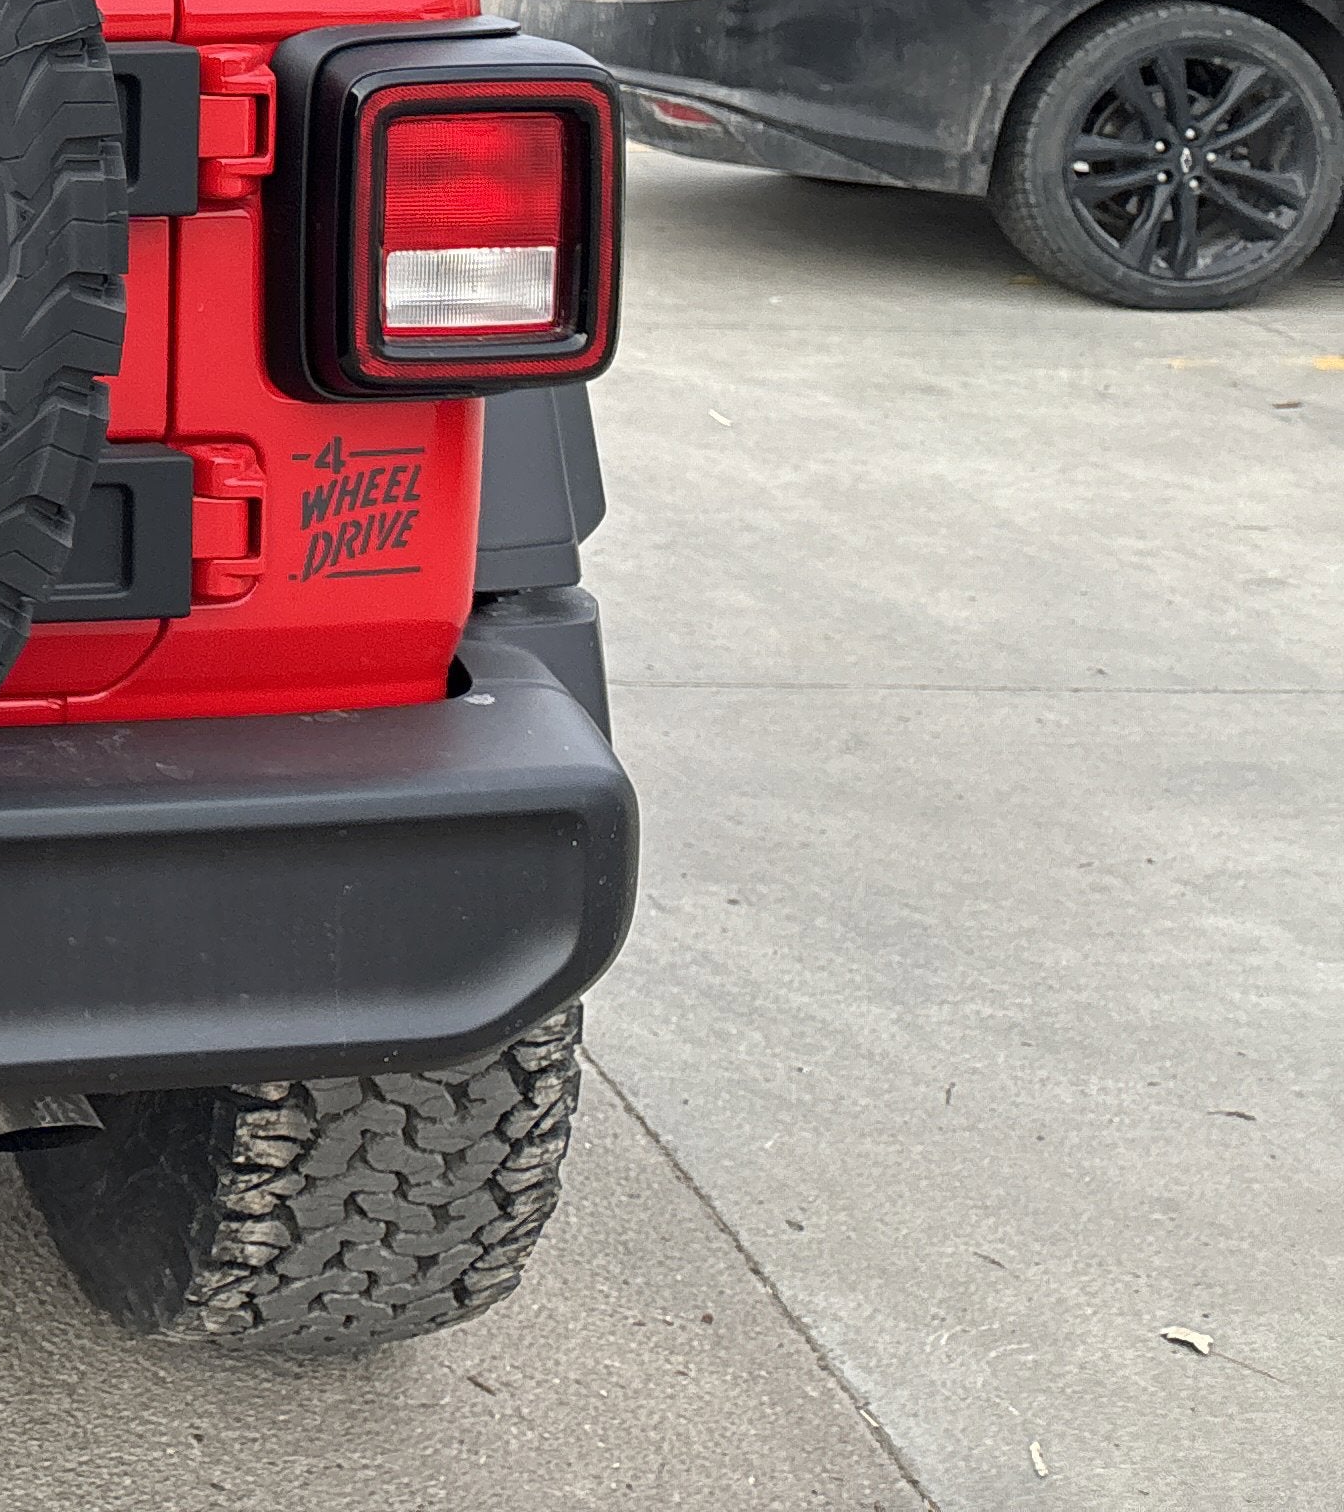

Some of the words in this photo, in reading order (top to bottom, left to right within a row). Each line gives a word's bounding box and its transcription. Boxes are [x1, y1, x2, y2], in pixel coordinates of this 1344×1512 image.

[314, 436, 346, 474] 4
[300, 463, 422, 530] WHEEL
[301, 509, 420, 582] DRIVE
